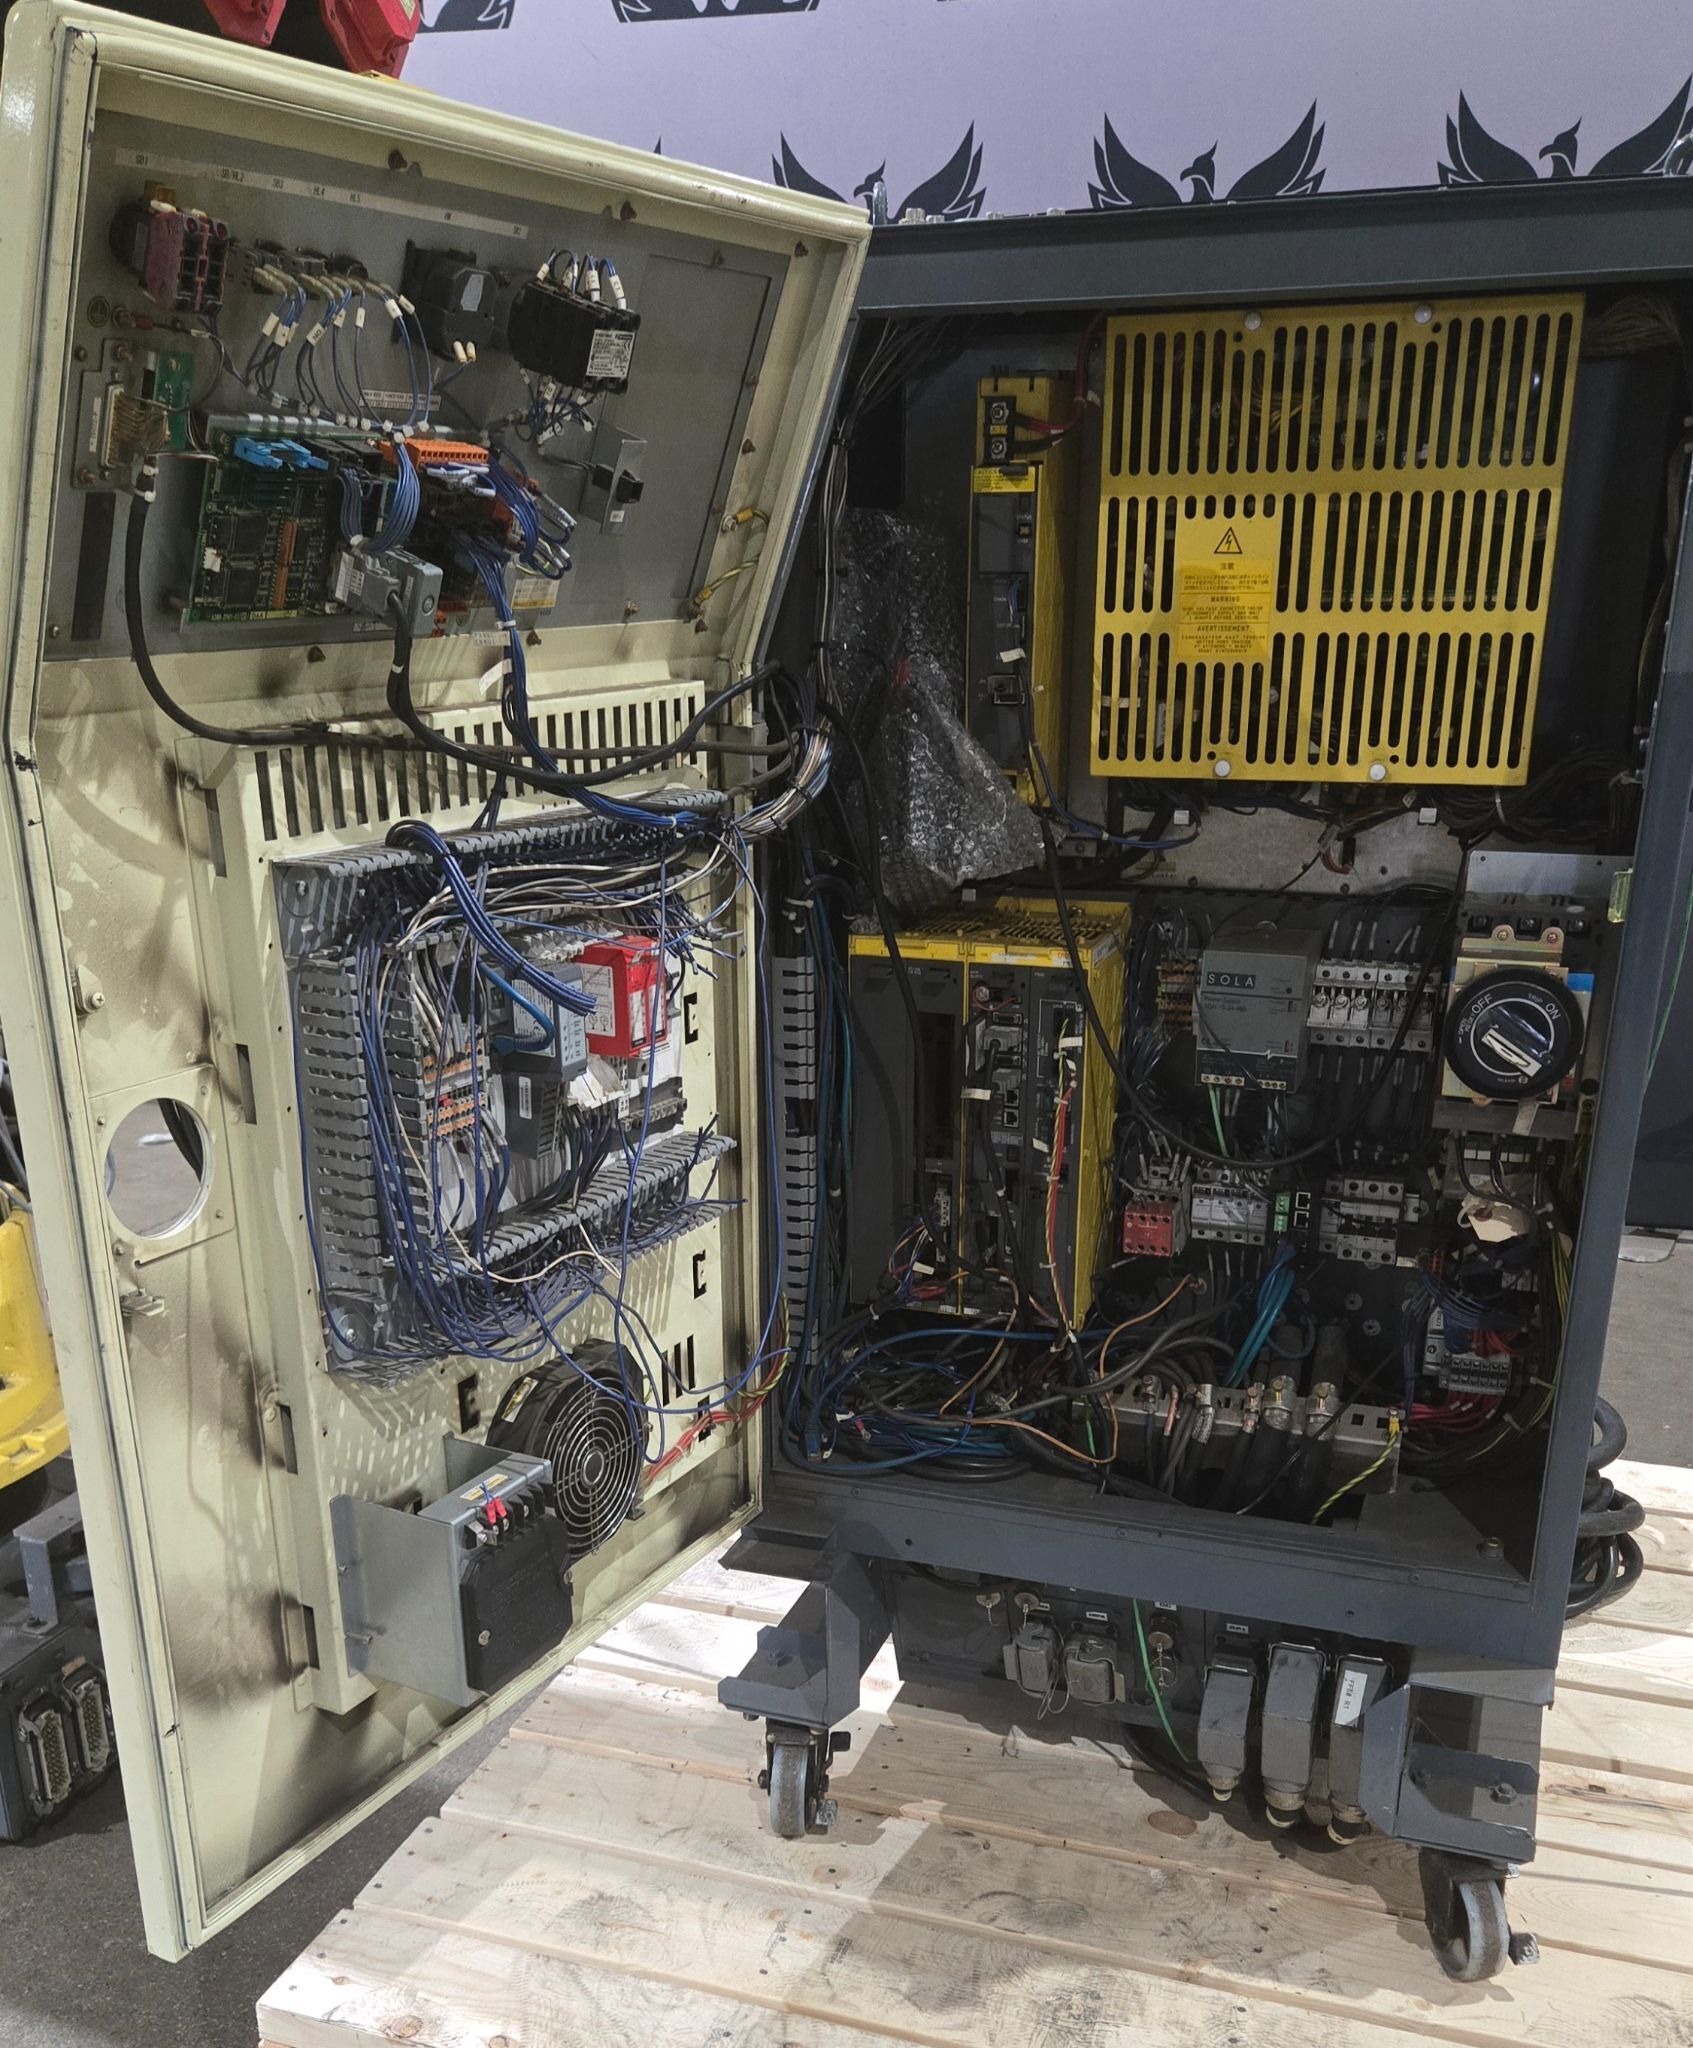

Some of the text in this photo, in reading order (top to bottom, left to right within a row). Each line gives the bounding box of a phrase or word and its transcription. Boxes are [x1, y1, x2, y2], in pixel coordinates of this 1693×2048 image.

[1208, 974, 1254, 986] SOLA
[1471, 993, 1494, 1014] OFF
[1545, 1003, 1562, 1020] ON
